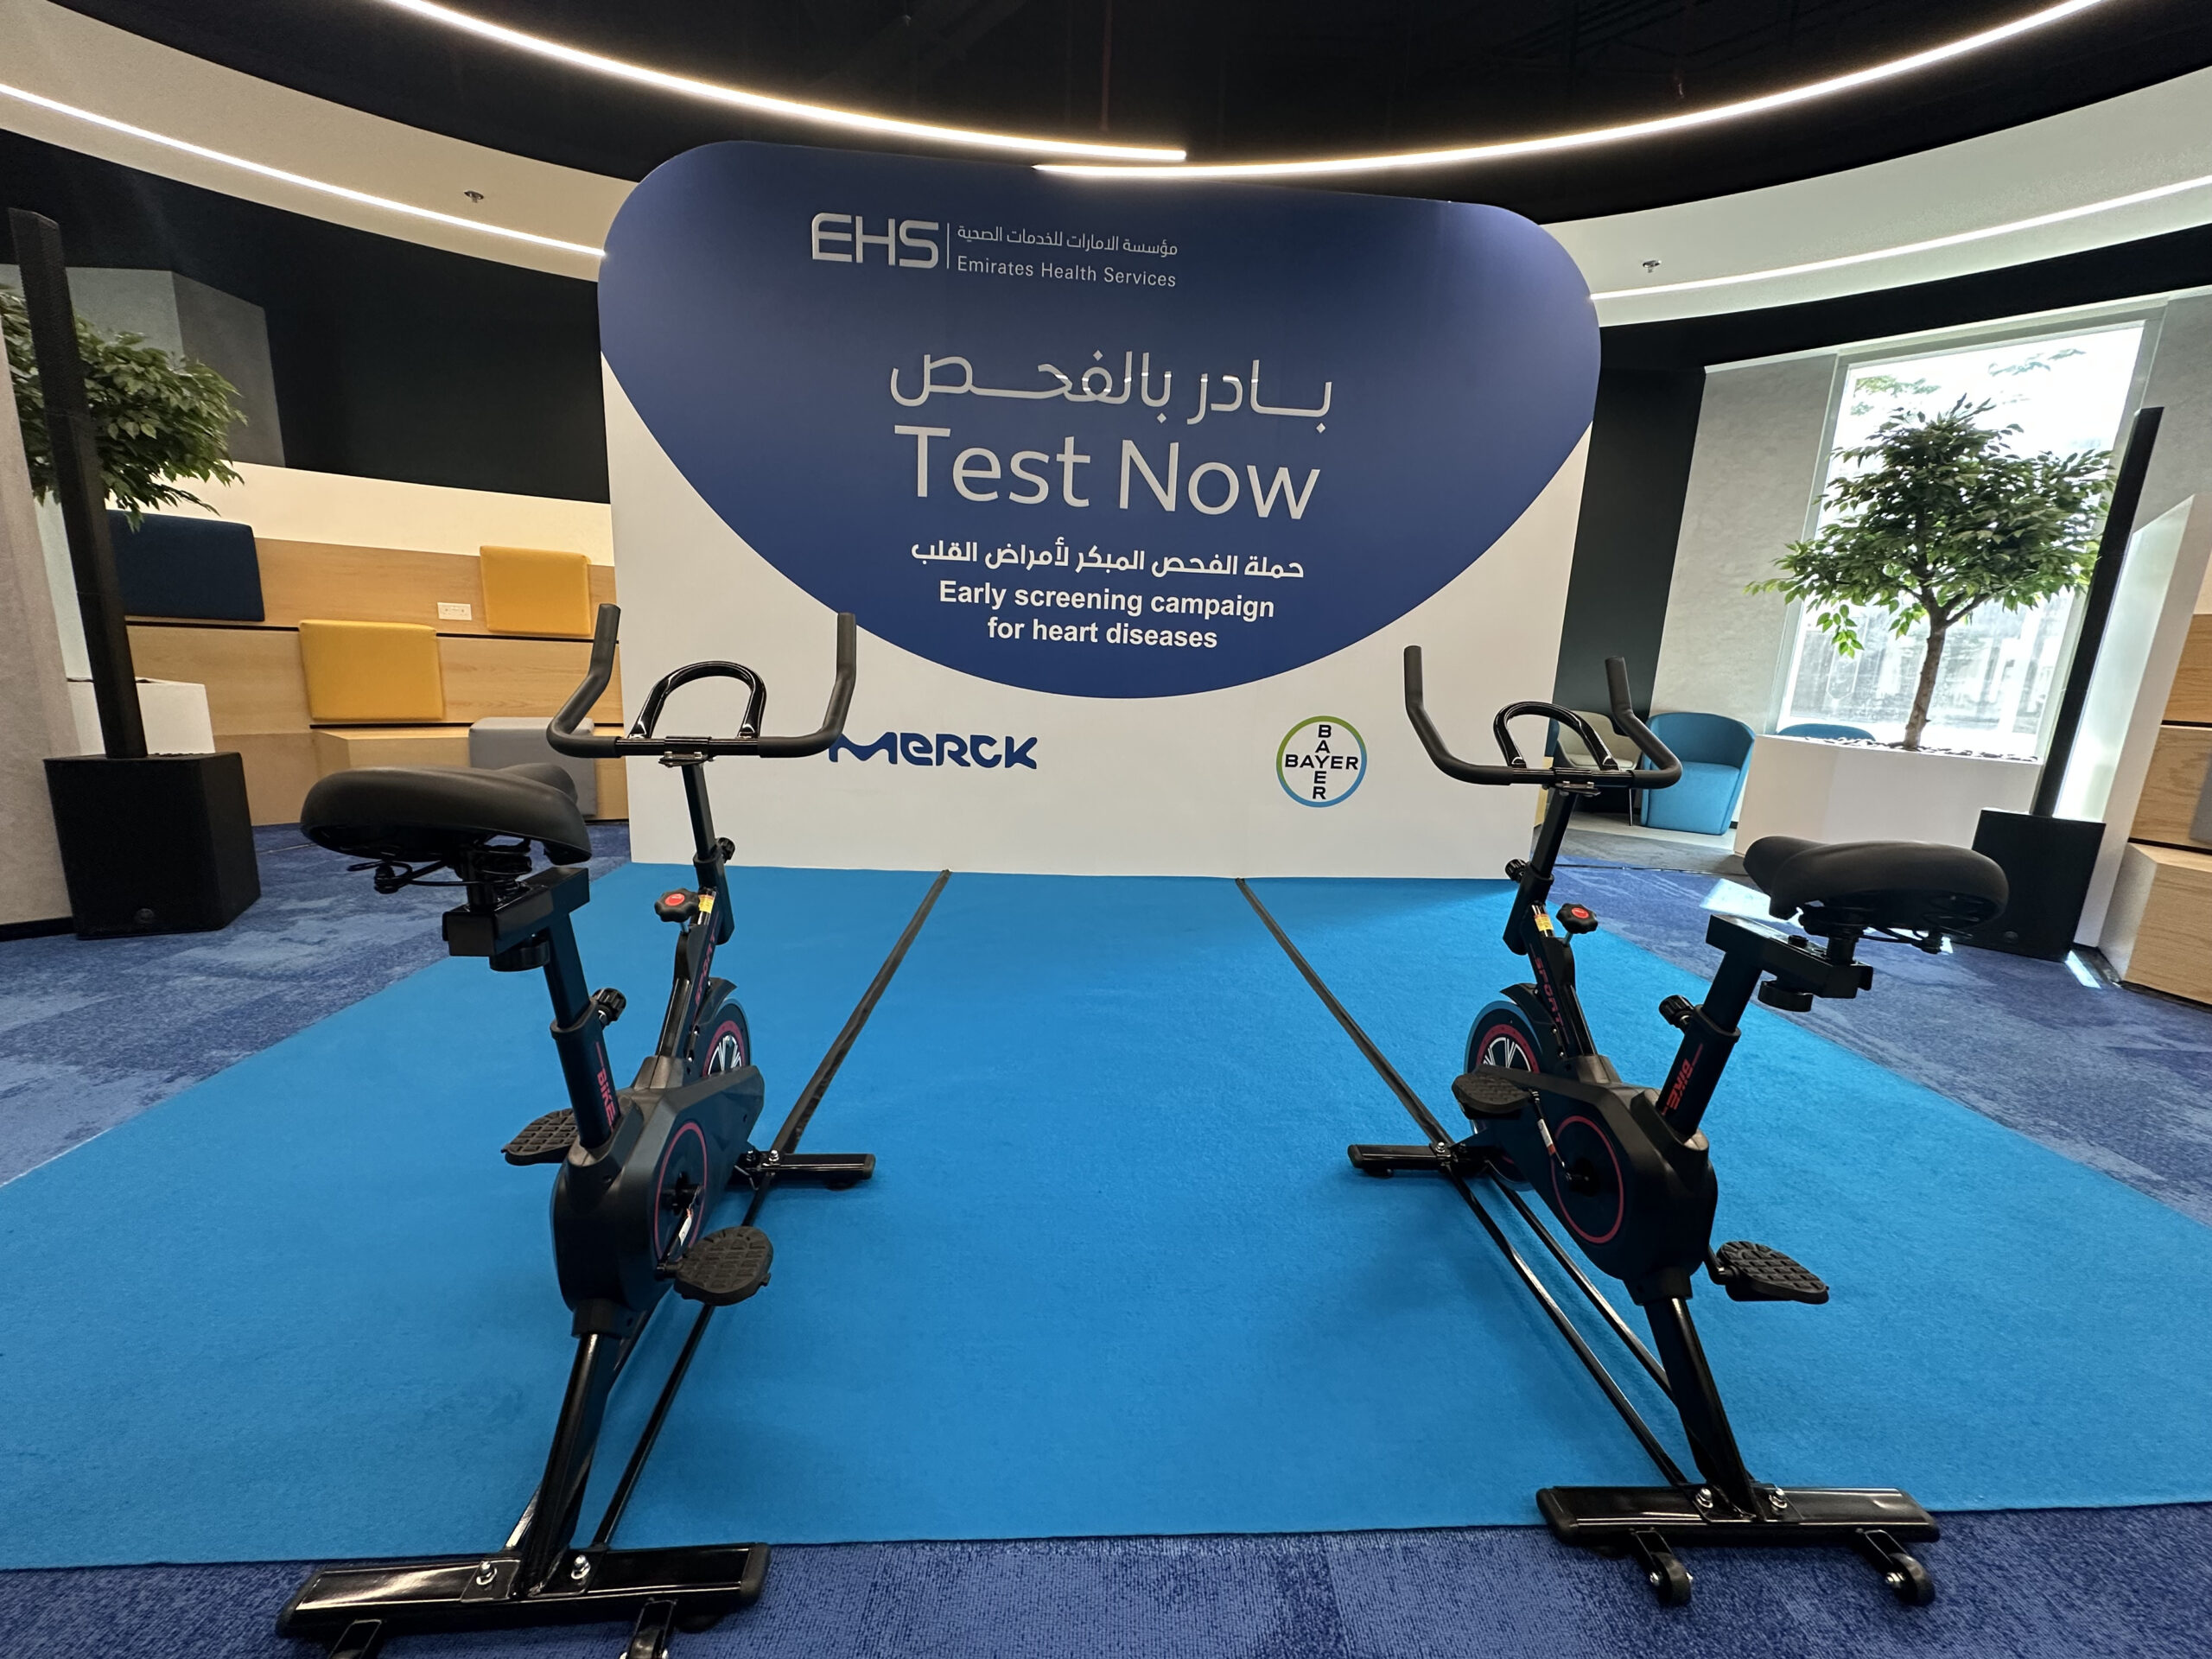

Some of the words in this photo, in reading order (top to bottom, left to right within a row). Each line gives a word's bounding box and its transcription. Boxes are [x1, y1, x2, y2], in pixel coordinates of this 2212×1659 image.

[811, 212, 939, 269] EHS
[957, 226, 1003, 243] الصحية
[1007, 227, 1064, 247] للخدمات
[1122, 238, 1178, 257] مؤسسة
[957, 255, 1034, 276] Emirates
[1041, 262, 1097, 282] Health
[1103, 267, 1177, 288] Services
[890, 349, 1173, 423] بالفحص
[1186, 359, 1332, 434] بادر
[894, 424, 1091, 507] Test
[1119, 439, 1321, 520] Now
[911, 539, 978, 566] القلب
[984, 536, 1070, 571] لأمراض
[1075, 544, 1145, 575] المبكر
[1151, 554, 1238, 578] الفحص
[1243, 555, 1304, 579] حملة
[939, 580, 1007, 610] Early
[1014, 588, 1142, 617] screening
[1150, 594, 1274, 622] campaign
[987, 616, 1026, 639] for
[1033, 618, 1099, 643] heart
[1106, 622, 1217, 648] diseases
[1285, 753, 1359, 770] BAYER
[1313, 724, 1332, 800] BAYER
